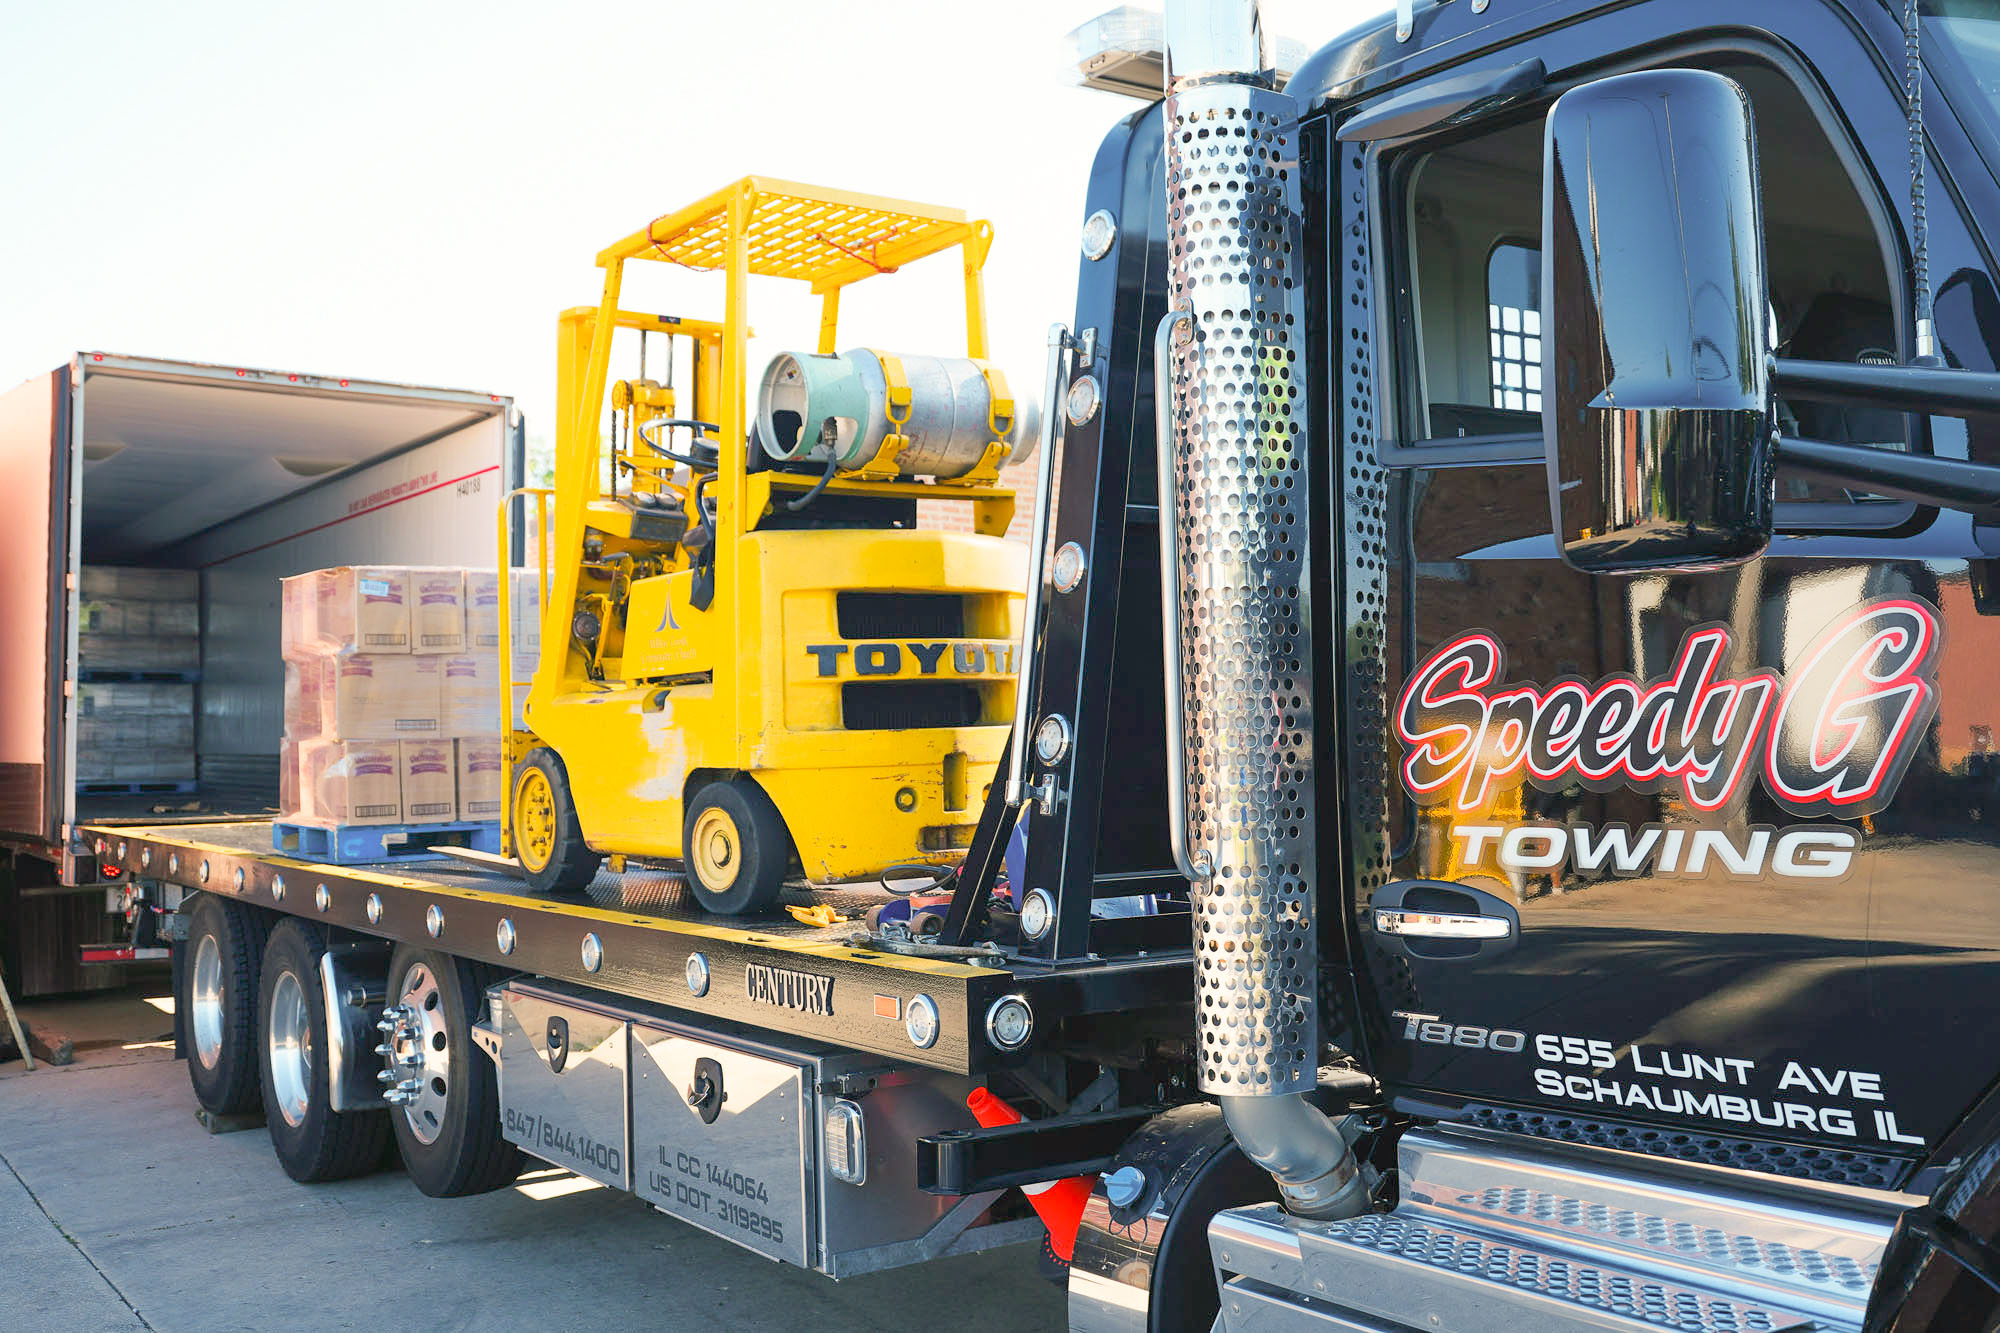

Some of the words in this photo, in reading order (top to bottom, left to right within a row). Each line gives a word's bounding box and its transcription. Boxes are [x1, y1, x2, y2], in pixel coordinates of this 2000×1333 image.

[1399, 628, 1776, 813] Speedy
[1765, 600, 1934, 806] G
[1452, 825, 1856, 878] TOWING
[744, 962, 835, 1017] CENTURY
[1391, 1009, 1527, 1053] T880
[1534, 1033, 1617, 1069] 655
[1630, 1044, 1755, 1086] LUNT
[1777, 1061, 1885, 1102] AVE
[1534, 1067, 1858, 1137] SCHAUMBURG
[1872, 1109, 1926, 1146] IL
[506, 1107, 620, 1175] 847/844.1400
[659, 1144, 672, 1168] IL
[677, 1151, 701, 1179] CC
[705, 1163, 769, 1206] 144064
[649, 1170, 672, 1198] US
[676, 1181, 711, 1213] DOT
[717, 1199, 784, 1244] 3119295
